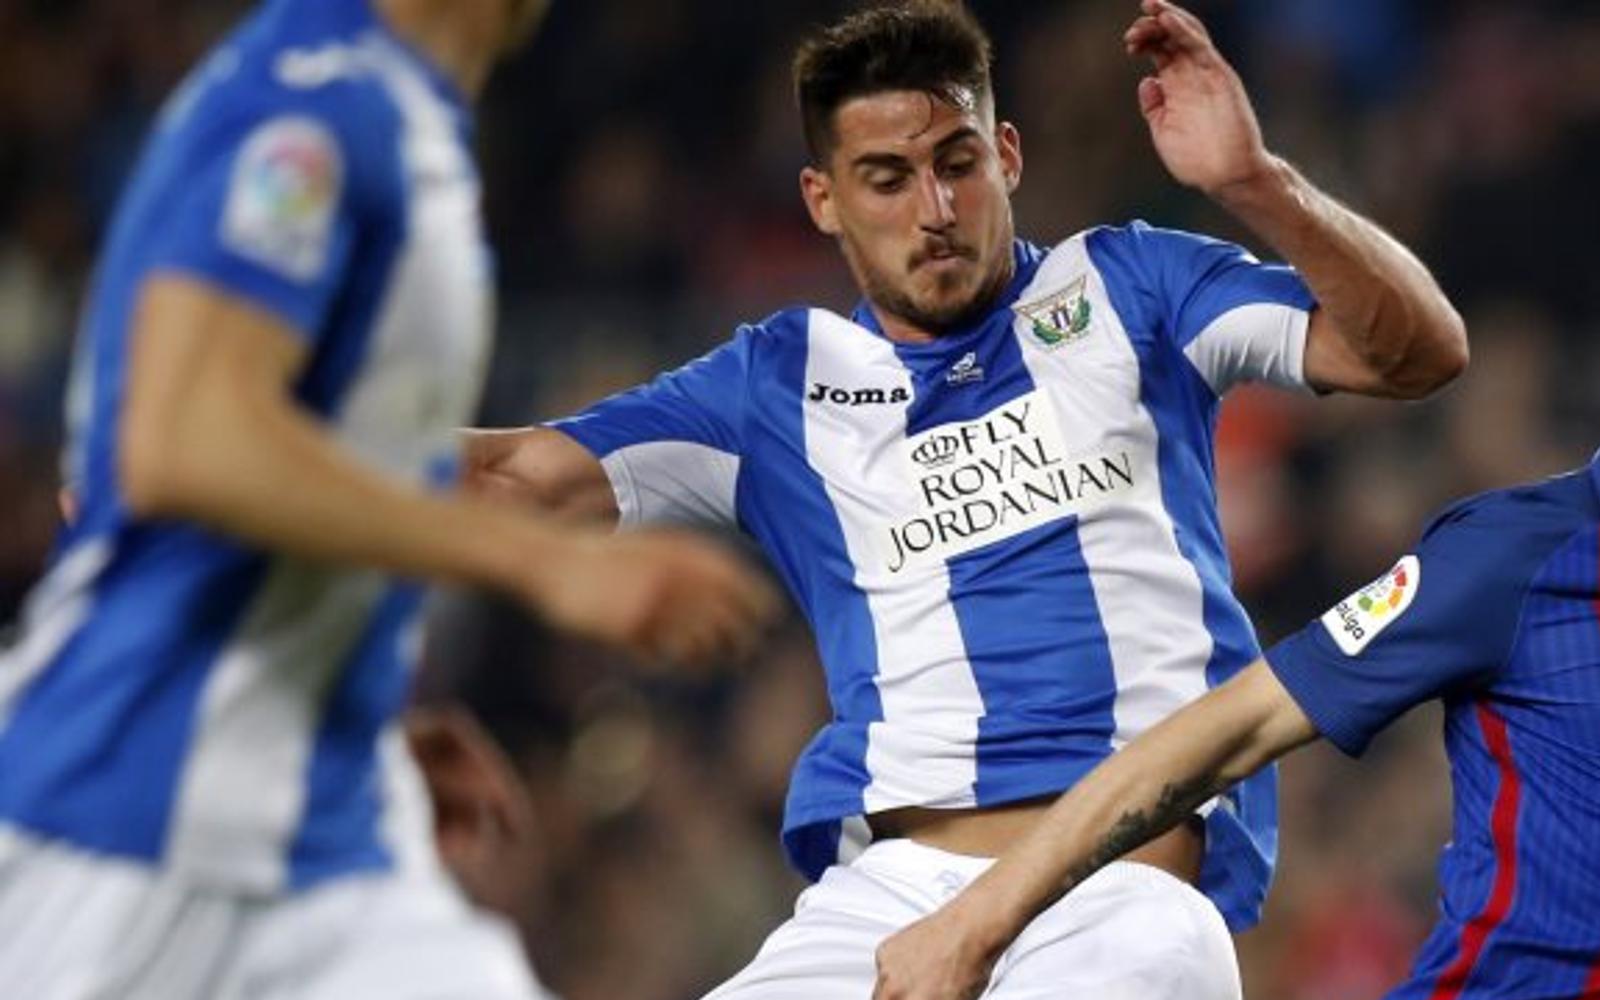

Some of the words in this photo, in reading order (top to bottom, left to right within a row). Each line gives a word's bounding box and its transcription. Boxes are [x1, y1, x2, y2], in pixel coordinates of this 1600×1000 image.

[808, 383, 910, 406] Joma
[960, 402, 1032, 456] FLY
[920, 437, 1062, 507] ROYAL
[888, 451, 1136, 573] JORDANIAN
